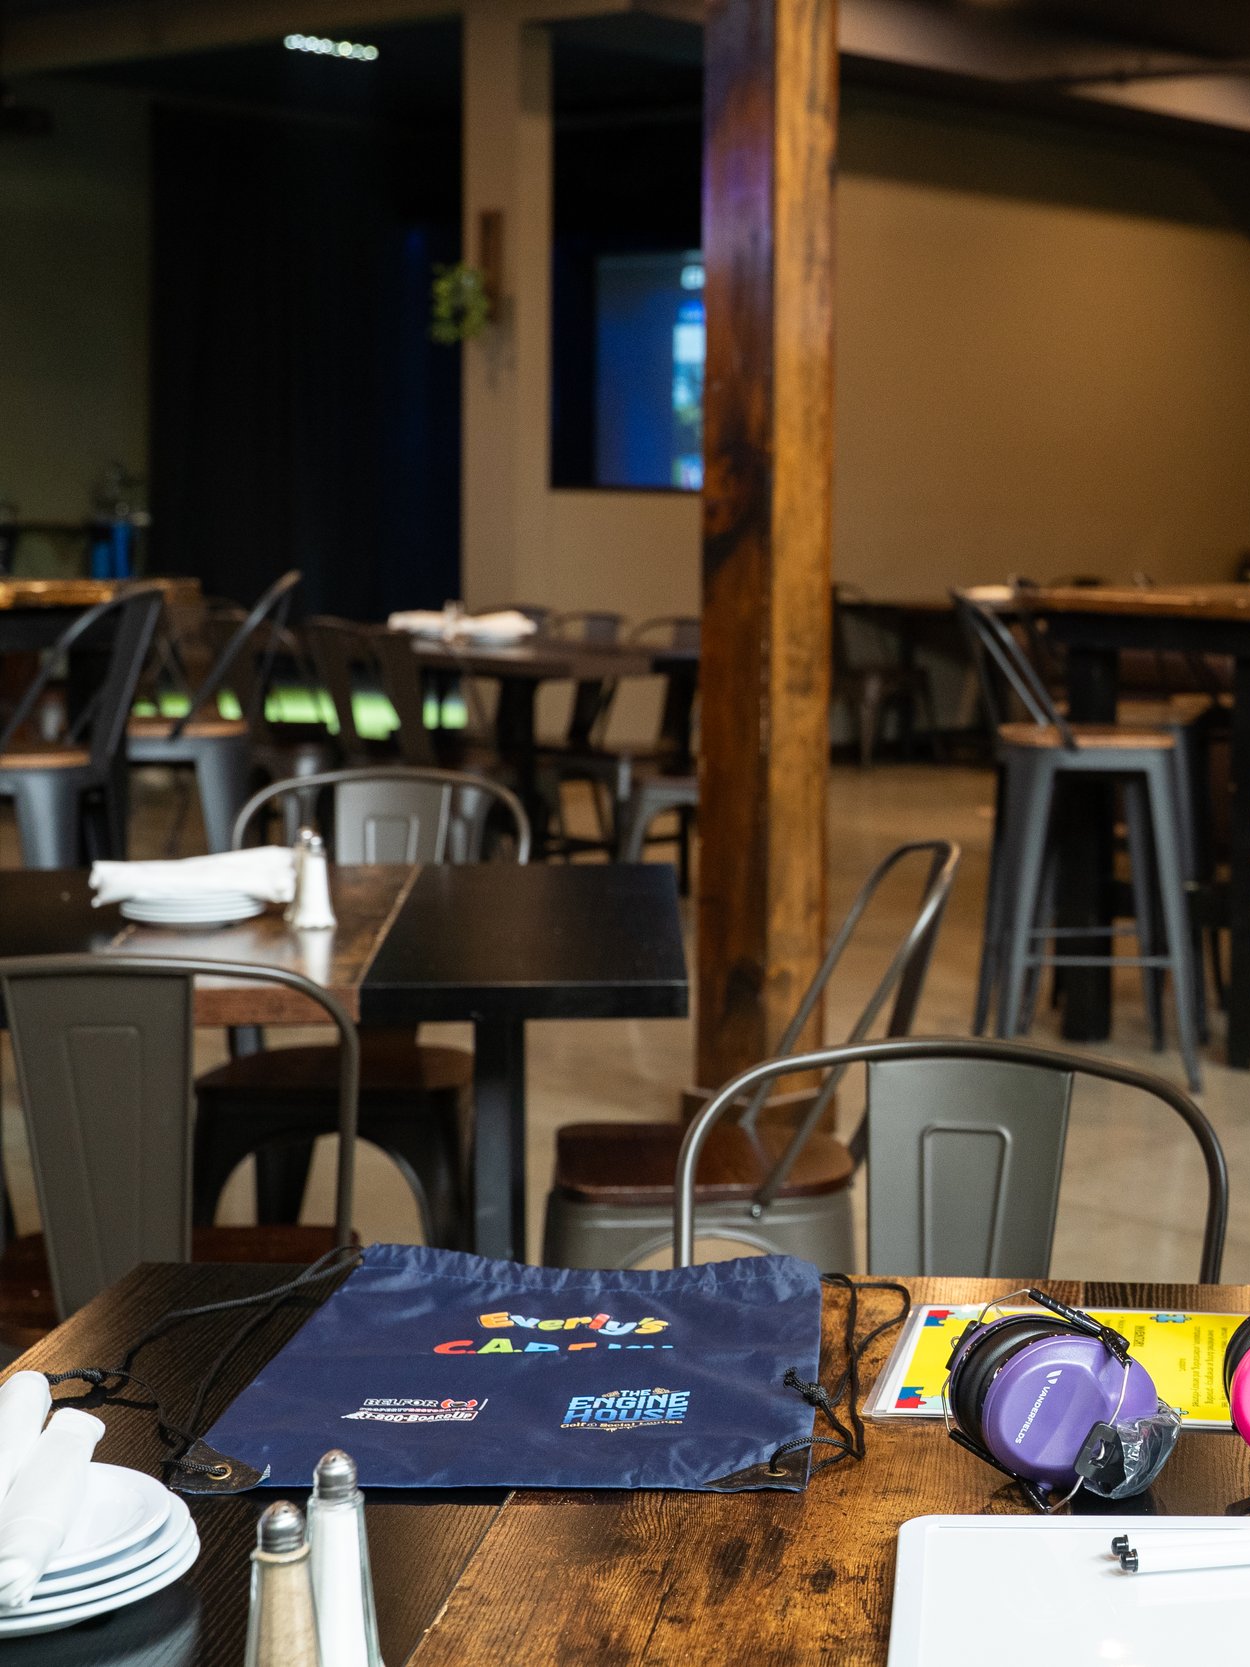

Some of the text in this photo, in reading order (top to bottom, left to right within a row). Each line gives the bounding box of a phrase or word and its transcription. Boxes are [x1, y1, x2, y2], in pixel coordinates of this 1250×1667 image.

[479, 1312, 670, 1336] Everly's
[568, 1391, 691, 1410] ENGINE
[620, 1389, 651, 1397] THE
[363, 1398, 439, 1407] BELFOR
[562, 1407, 688, 1424] HOUSE
[1015, 1386, 1051, 1444] VANDERFIELDS
